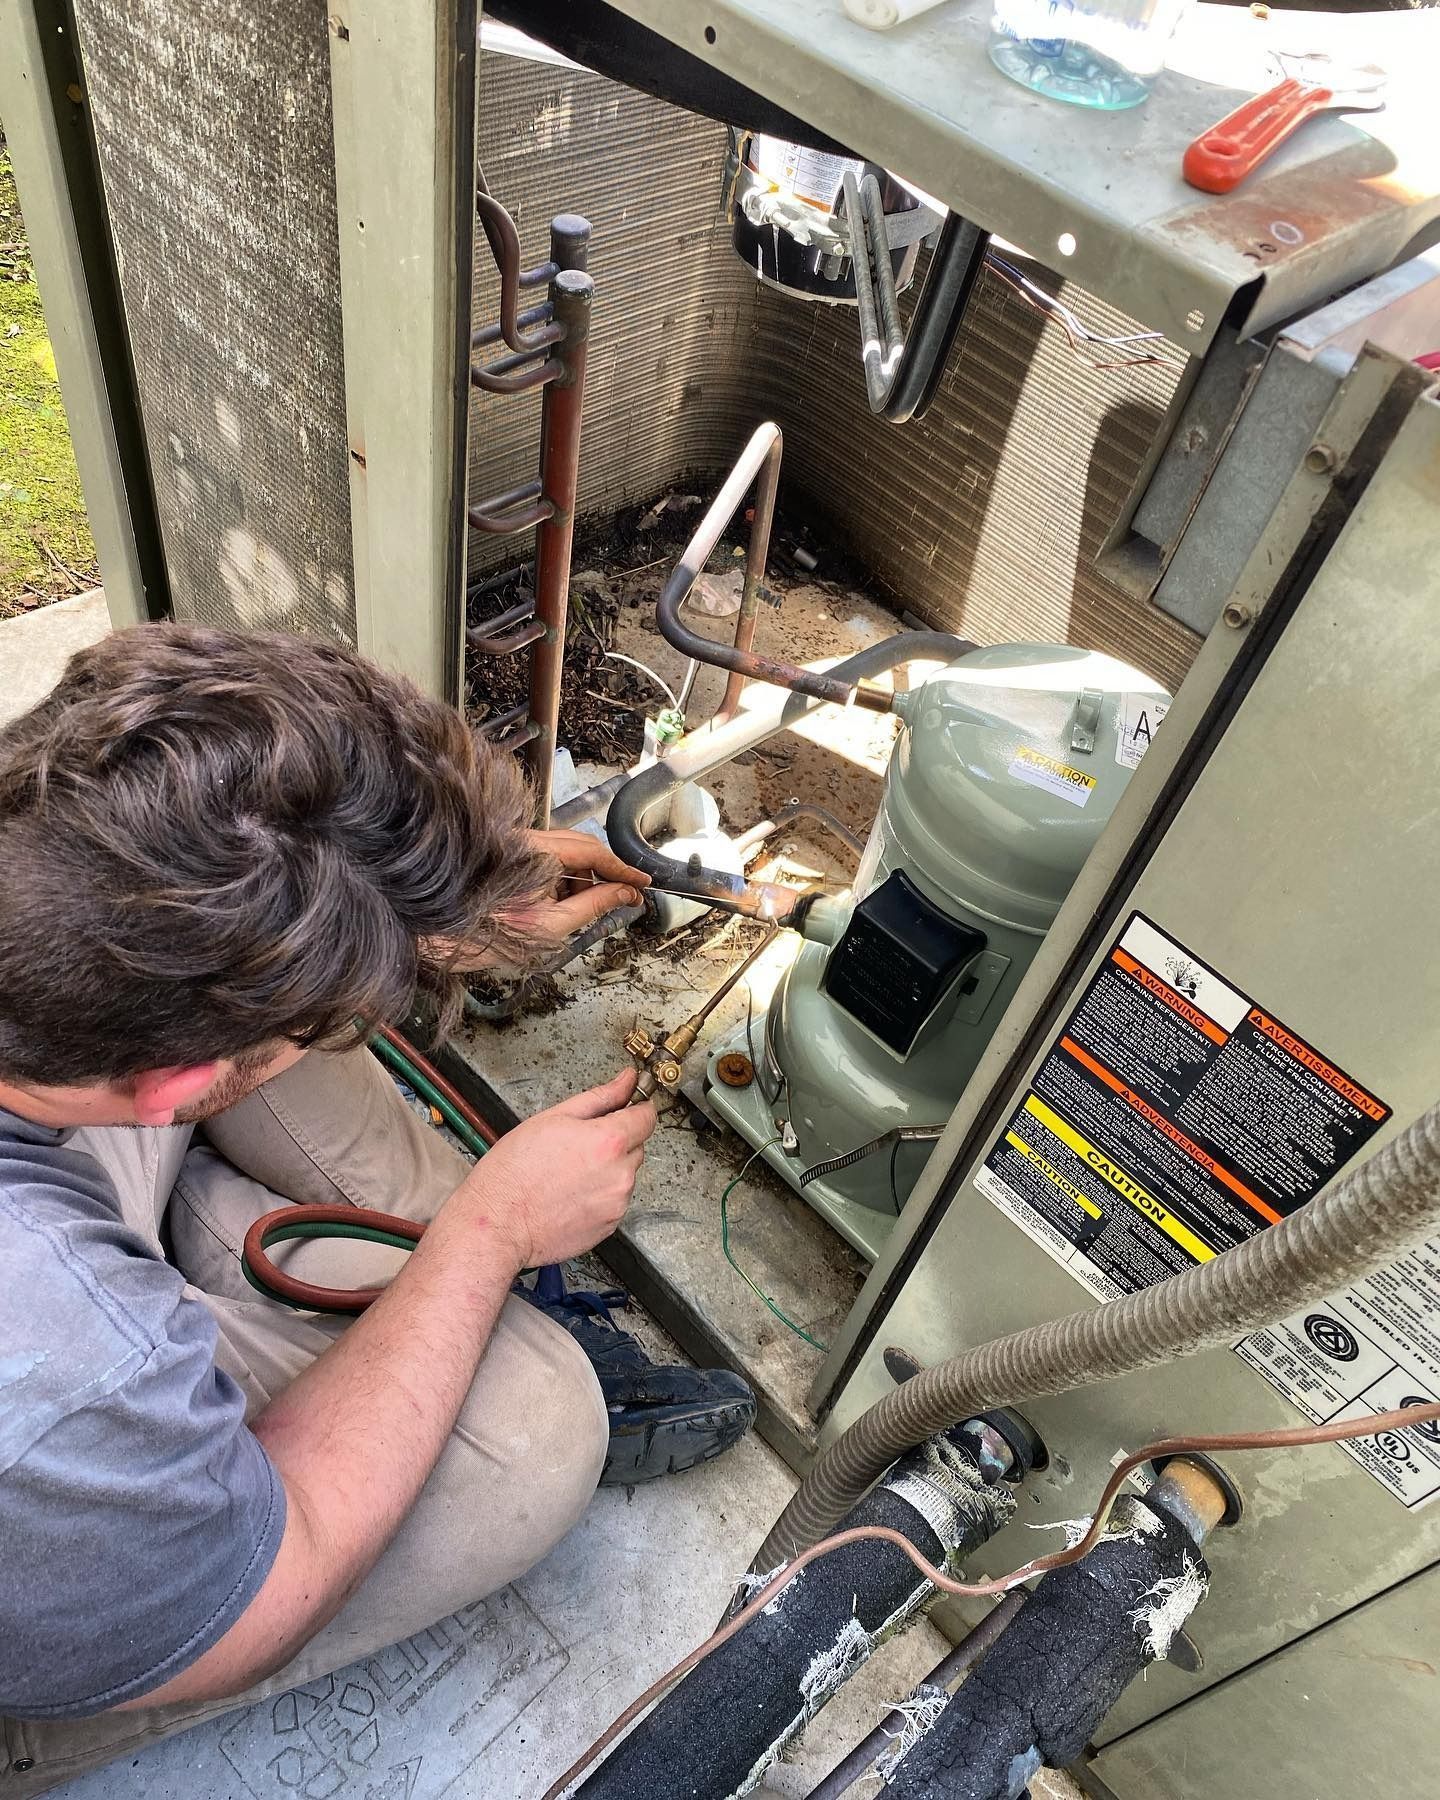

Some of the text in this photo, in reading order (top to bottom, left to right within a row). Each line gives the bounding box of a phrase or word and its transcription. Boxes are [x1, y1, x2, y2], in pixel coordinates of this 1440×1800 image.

[1114, 968, 1211, 1048] CONTAINS REFRIGERANT!
[1143, 975, 1205, 1028] WARNING
[1251, 1030, 1363, 1120] CE PRODUIT CONTIENT UN
[1254, 1042, 1287, 1070] FLUIDE
[1263, 1022, 1383, 1119] AVERTISSEMENT
[1021, 1108, 1077, 1159] PHASE ROTATION
[1131, 1096, 1216, 1171] ADVERTENCIA
[1151, 1128, 1211, 1180] REFRIGERANTE!
[1026, 1149, 1079, 1199] CAUTION
[1085, 1148, 1166, 1222] CAUTION
[1415, 1277, 1428, 1287] 45
[1344, 1294, 1427, 1364] ASSEMBLED IN
[1368, 1298, 1406, 1329] NAMEPLATE
[1421, 1303, 1434, 1313] 45
[1362, 1438, 1404, 1474] LISTED
[1404, 1460, 1420, 1474] US
